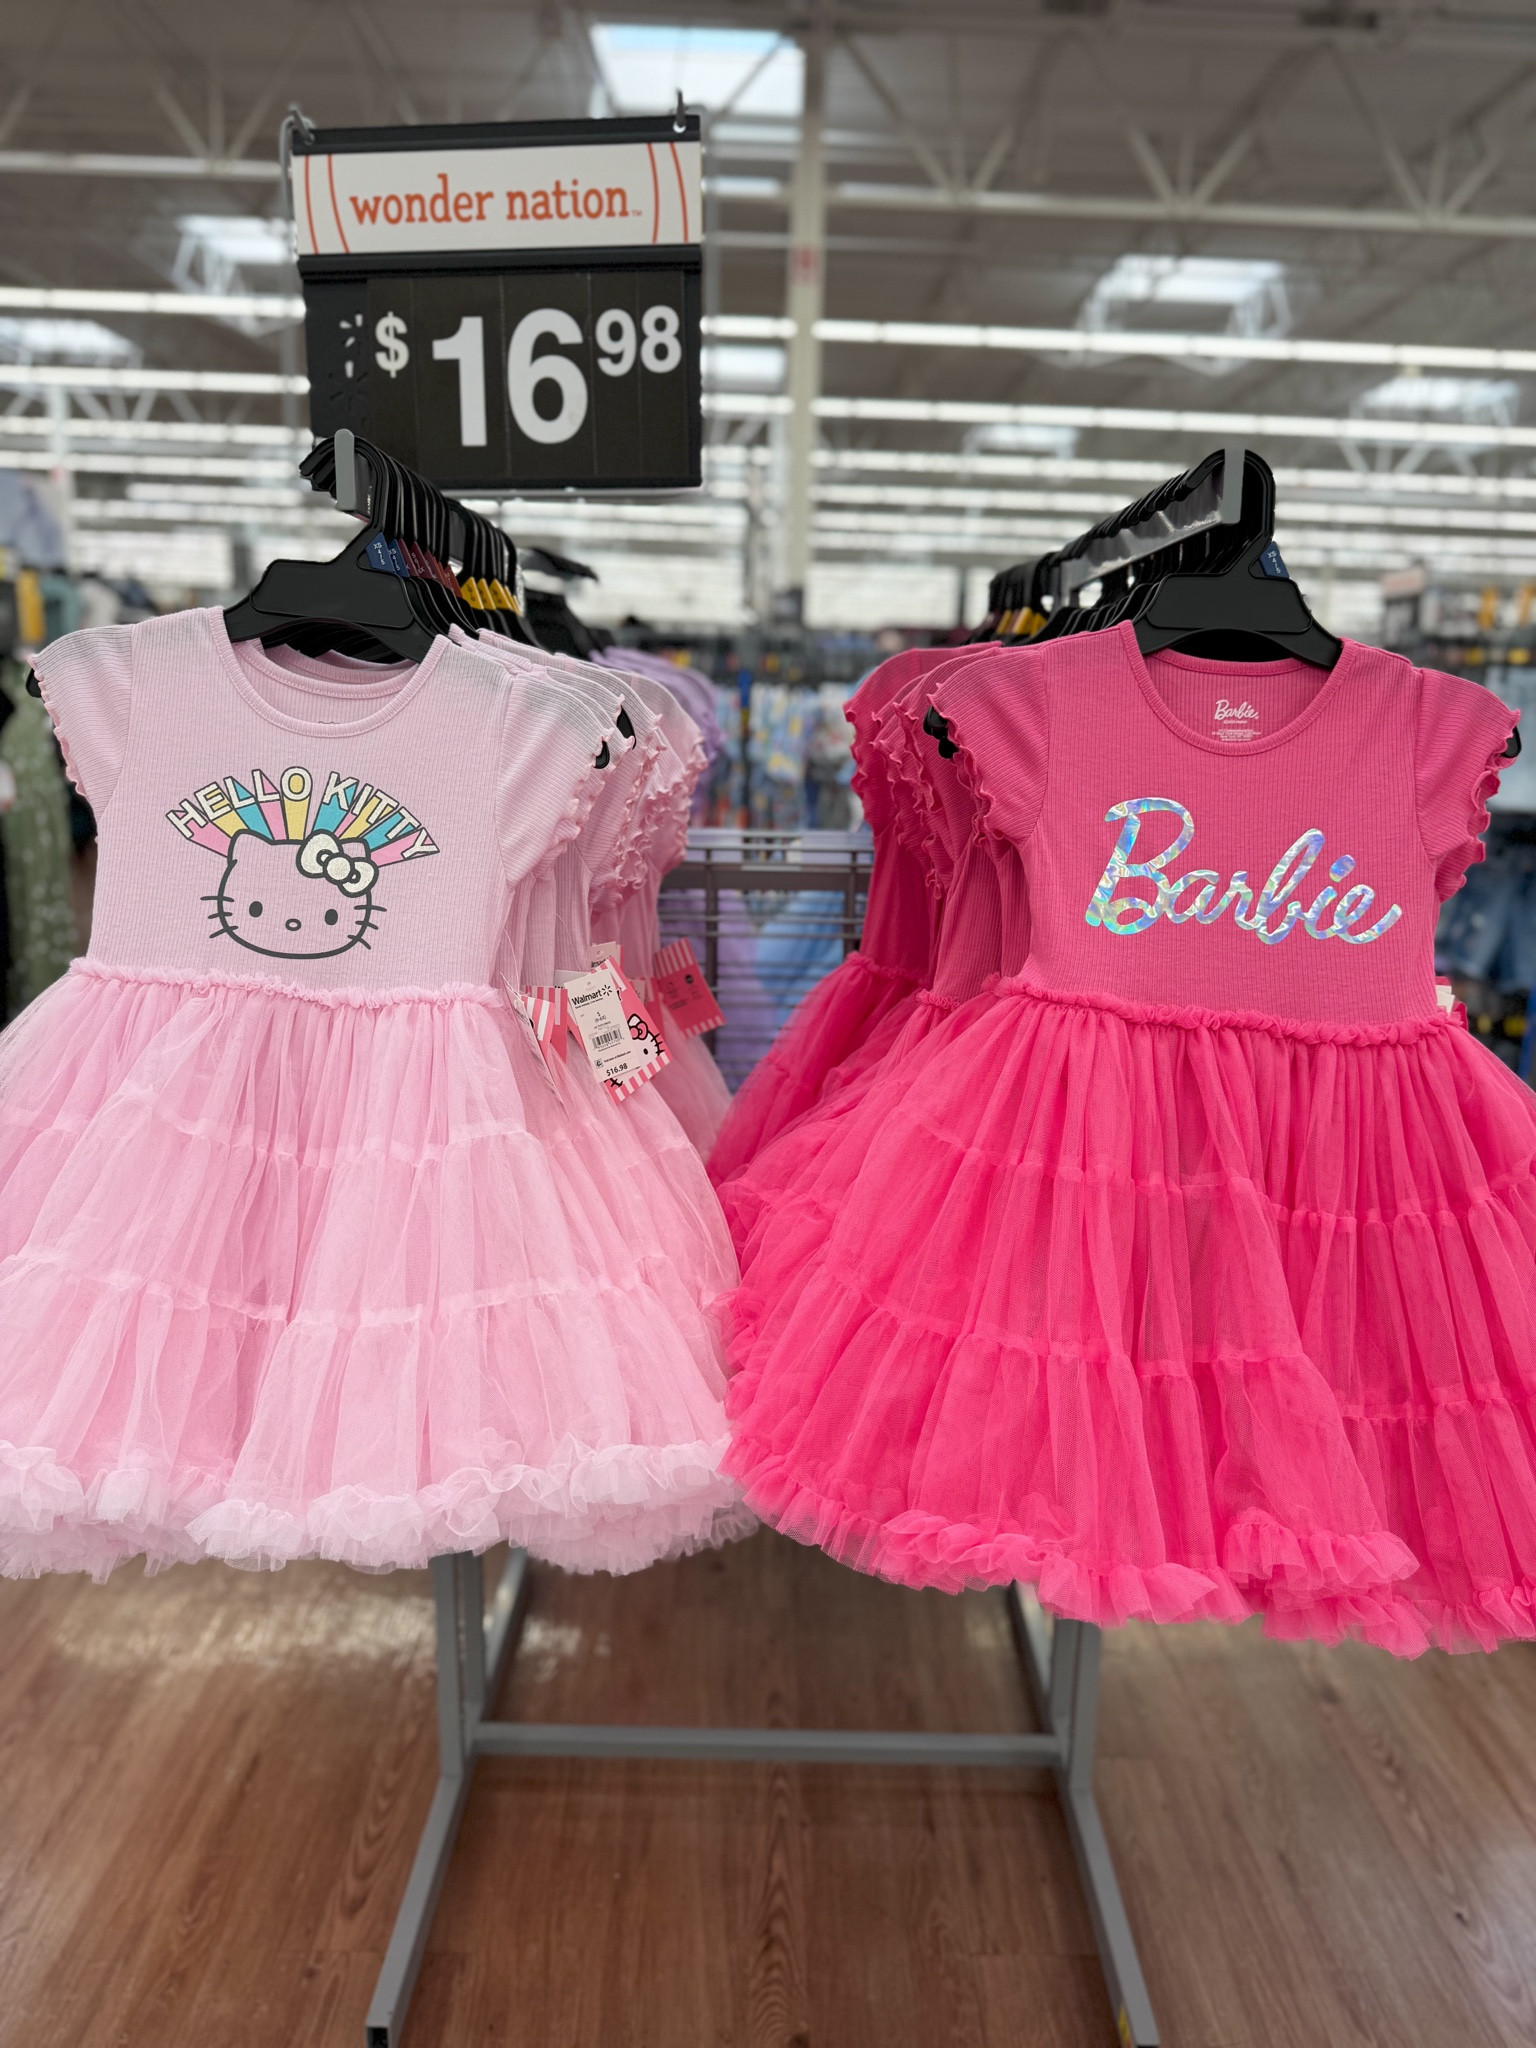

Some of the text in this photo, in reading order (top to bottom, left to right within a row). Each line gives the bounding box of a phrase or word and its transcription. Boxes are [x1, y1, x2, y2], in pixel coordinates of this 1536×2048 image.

[349, 173, 494, 225] wonder
[505, 177, 630, 221] nation
[1213, 699, 1259, 720] Barbie
[165, 766, 440, 860] HELLO KITTY
[1085, 796, 1403, 945] Barbie
[571, 989, 603, 1006] Walmart
[606, 1062, 628, 1077] $16.98
